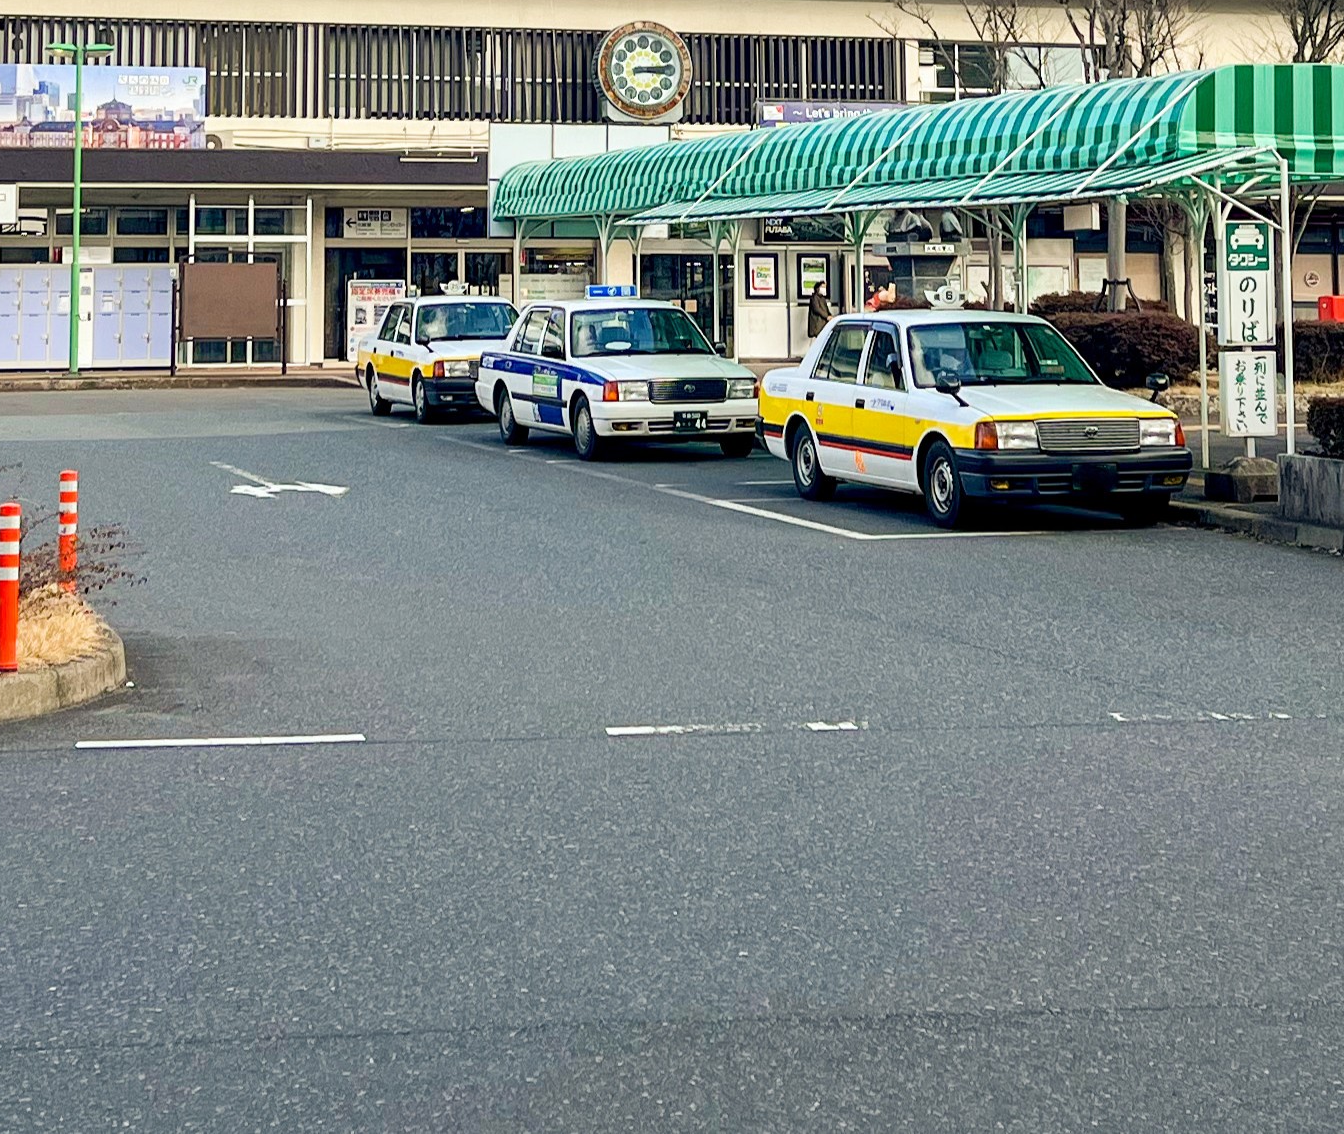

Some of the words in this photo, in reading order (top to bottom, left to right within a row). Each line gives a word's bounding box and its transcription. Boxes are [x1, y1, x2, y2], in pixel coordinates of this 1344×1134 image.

[1228, 253, 1267, 266] タクシー
[1239, 276, 1258, 342] のりば
